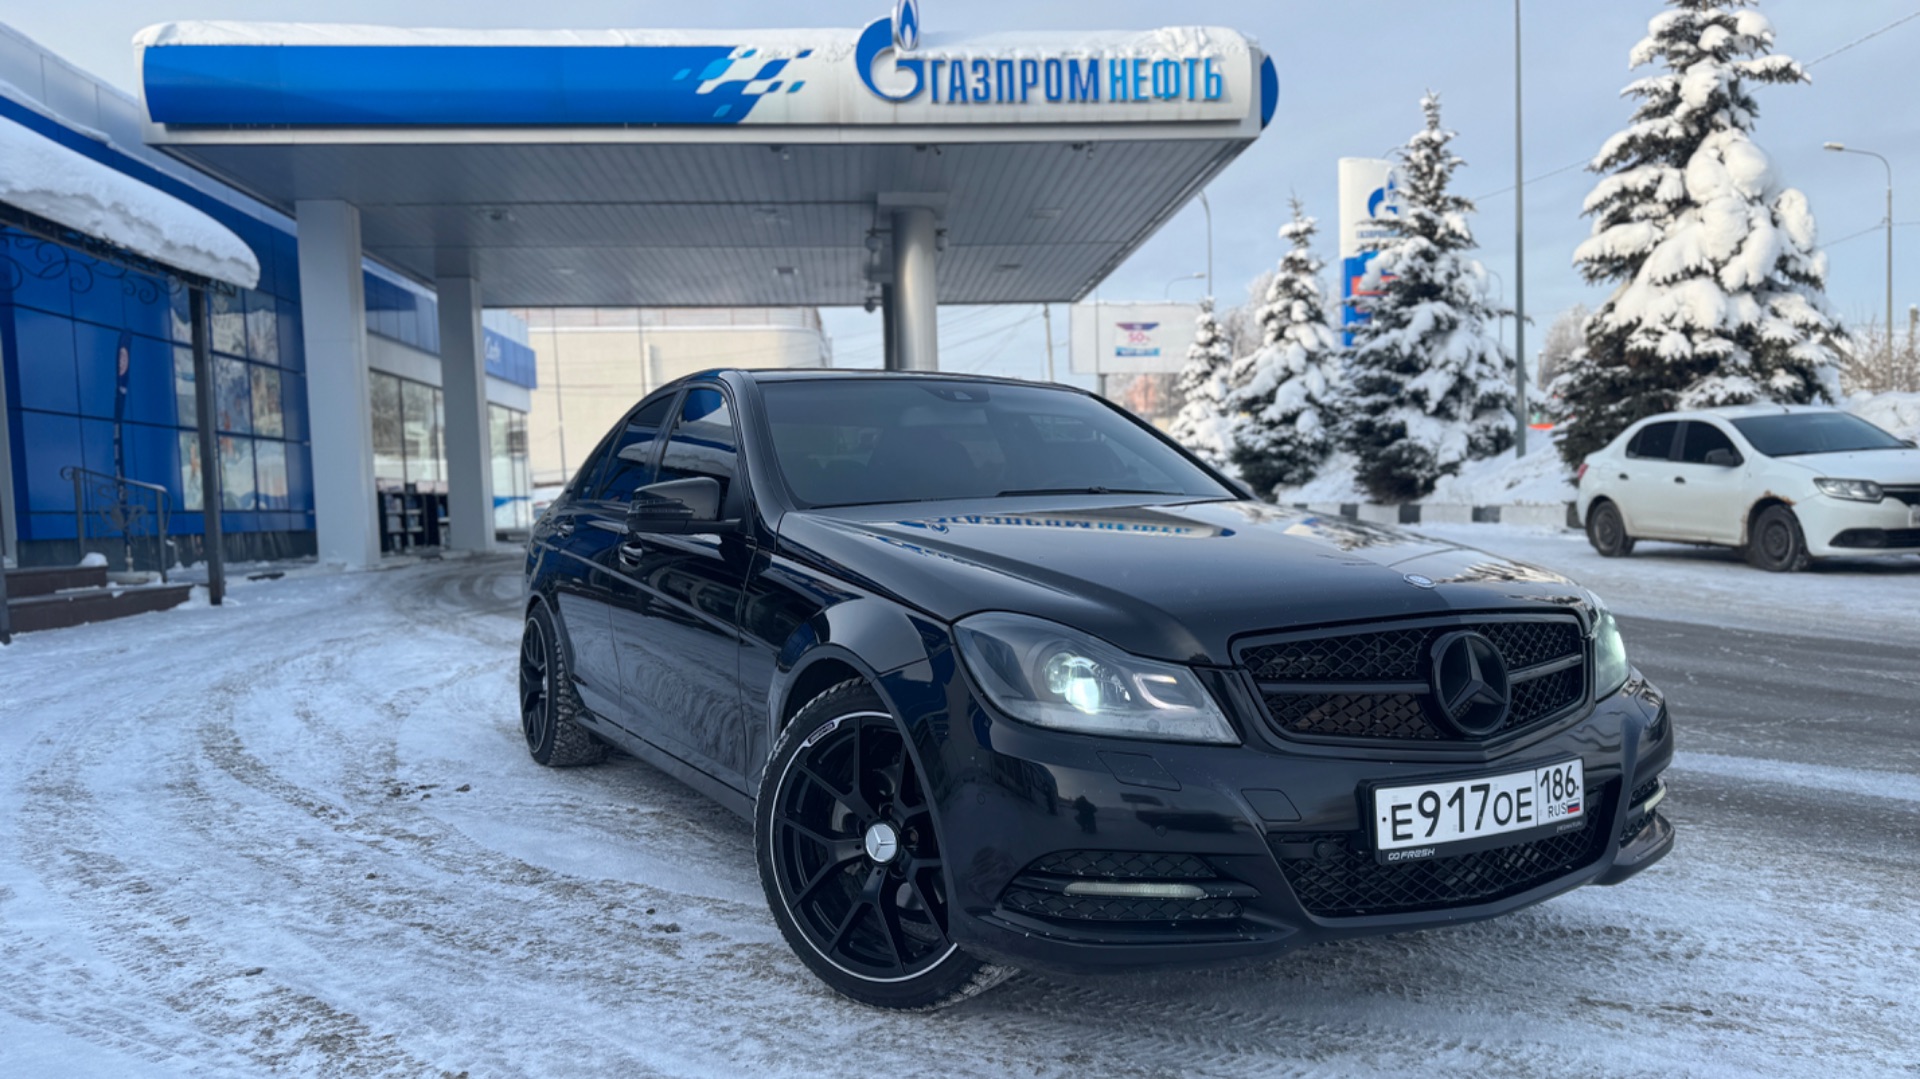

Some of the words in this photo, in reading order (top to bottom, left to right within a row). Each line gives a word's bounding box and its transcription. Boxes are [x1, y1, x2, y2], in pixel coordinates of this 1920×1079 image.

[930, 58, 1099, 105] ГАЗПРОМ
[1109, 57, 1223, 102] НЕФТЬ
[1540, 765, 1575, 804] 186
[1548, 802, 1567, 817] RUS
